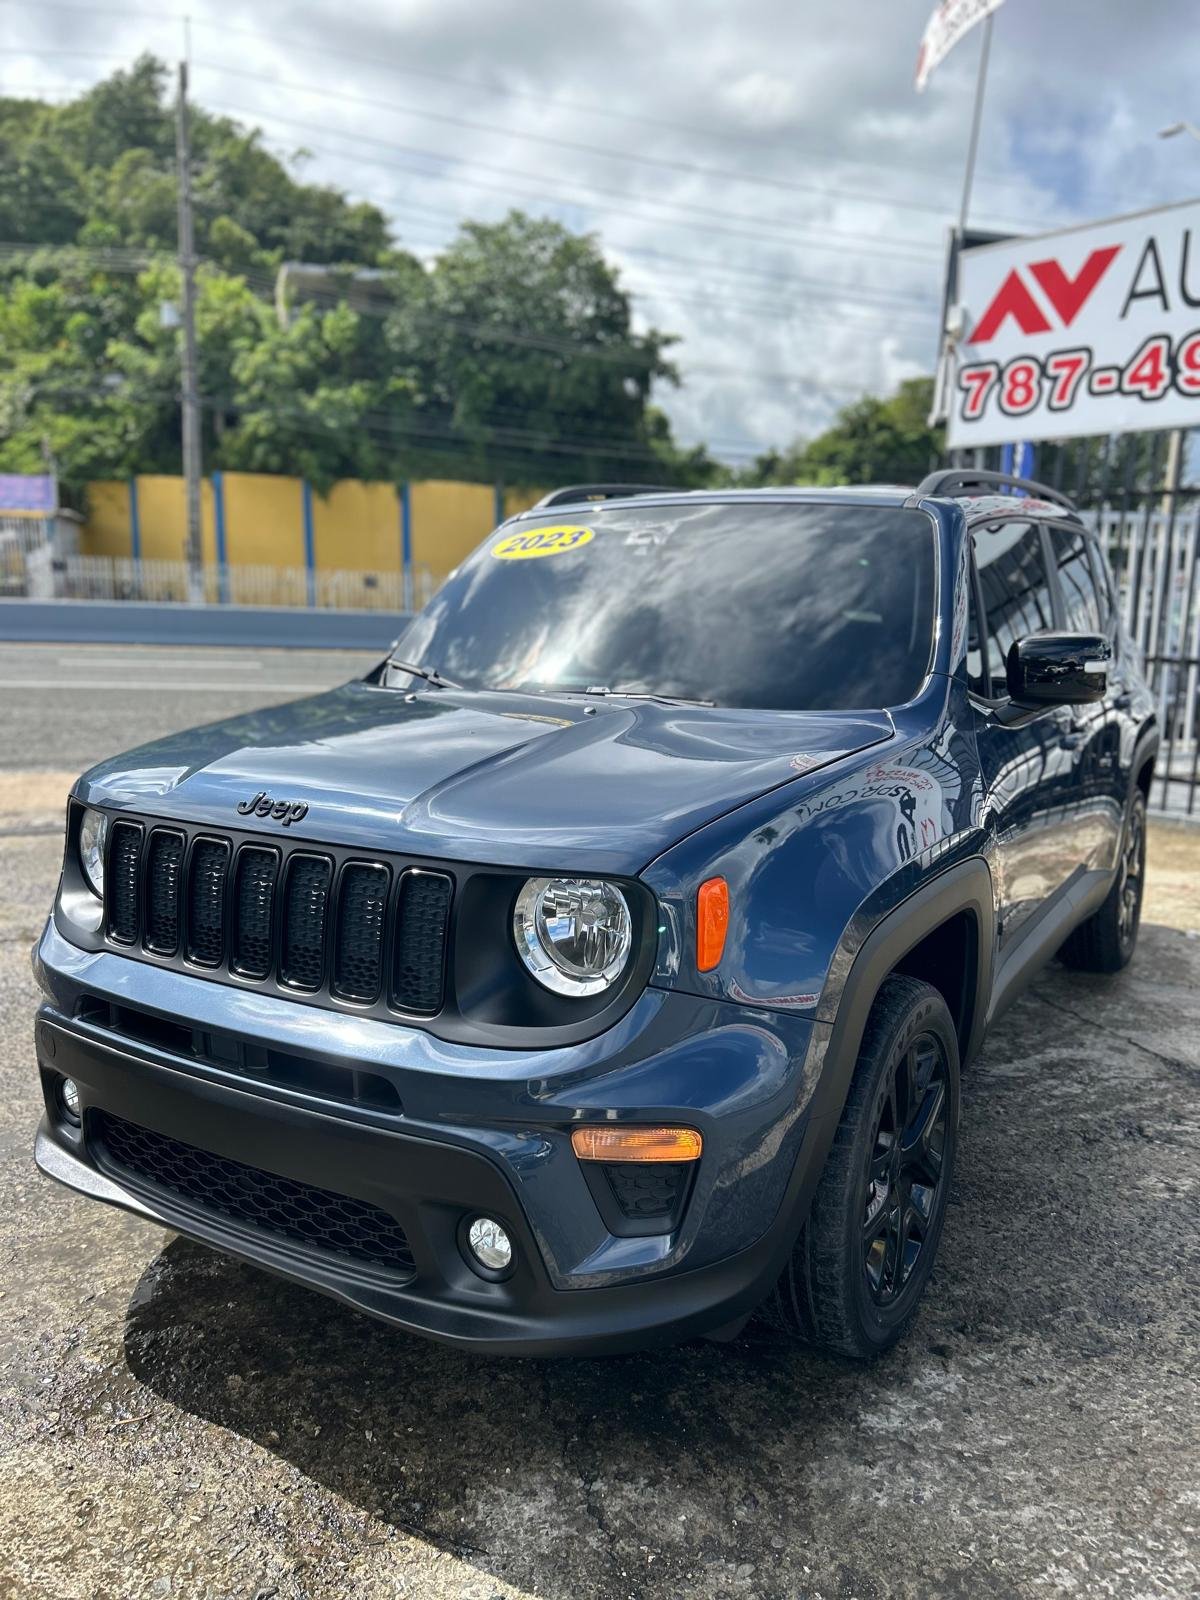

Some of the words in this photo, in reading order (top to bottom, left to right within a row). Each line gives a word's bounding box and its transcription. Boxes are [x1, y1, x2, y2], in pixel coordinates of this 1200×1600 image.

[967, 244, 1125, 346] AV
[499, 530, 586, 554] 2023
[237, 791, 309, 826] Jeep
